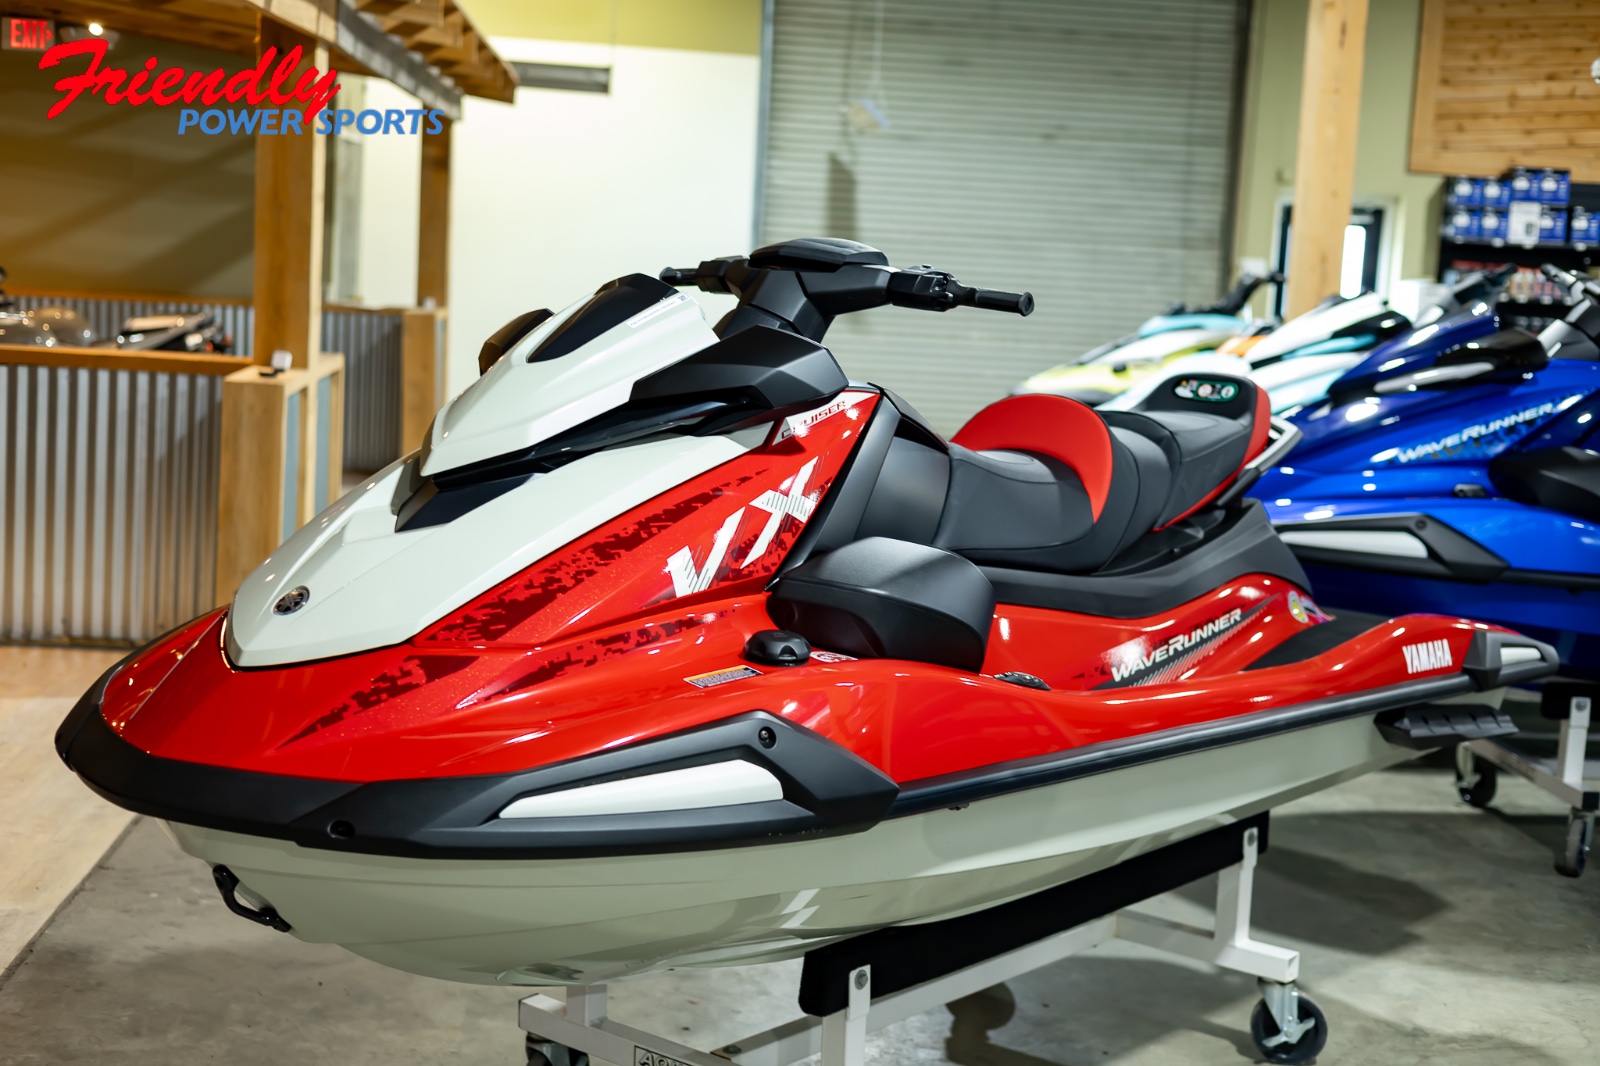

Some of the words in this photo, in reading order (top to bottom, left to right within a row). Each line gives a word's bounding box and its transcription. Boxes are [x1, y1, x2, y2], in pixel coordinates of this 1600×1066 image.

[10, 18, 48, 49] EXIT
[781, 400, 846, 439] CUISER
[664, 456, 822, 598] VX
[1401, 638, 1453, 674] YAMAHA
